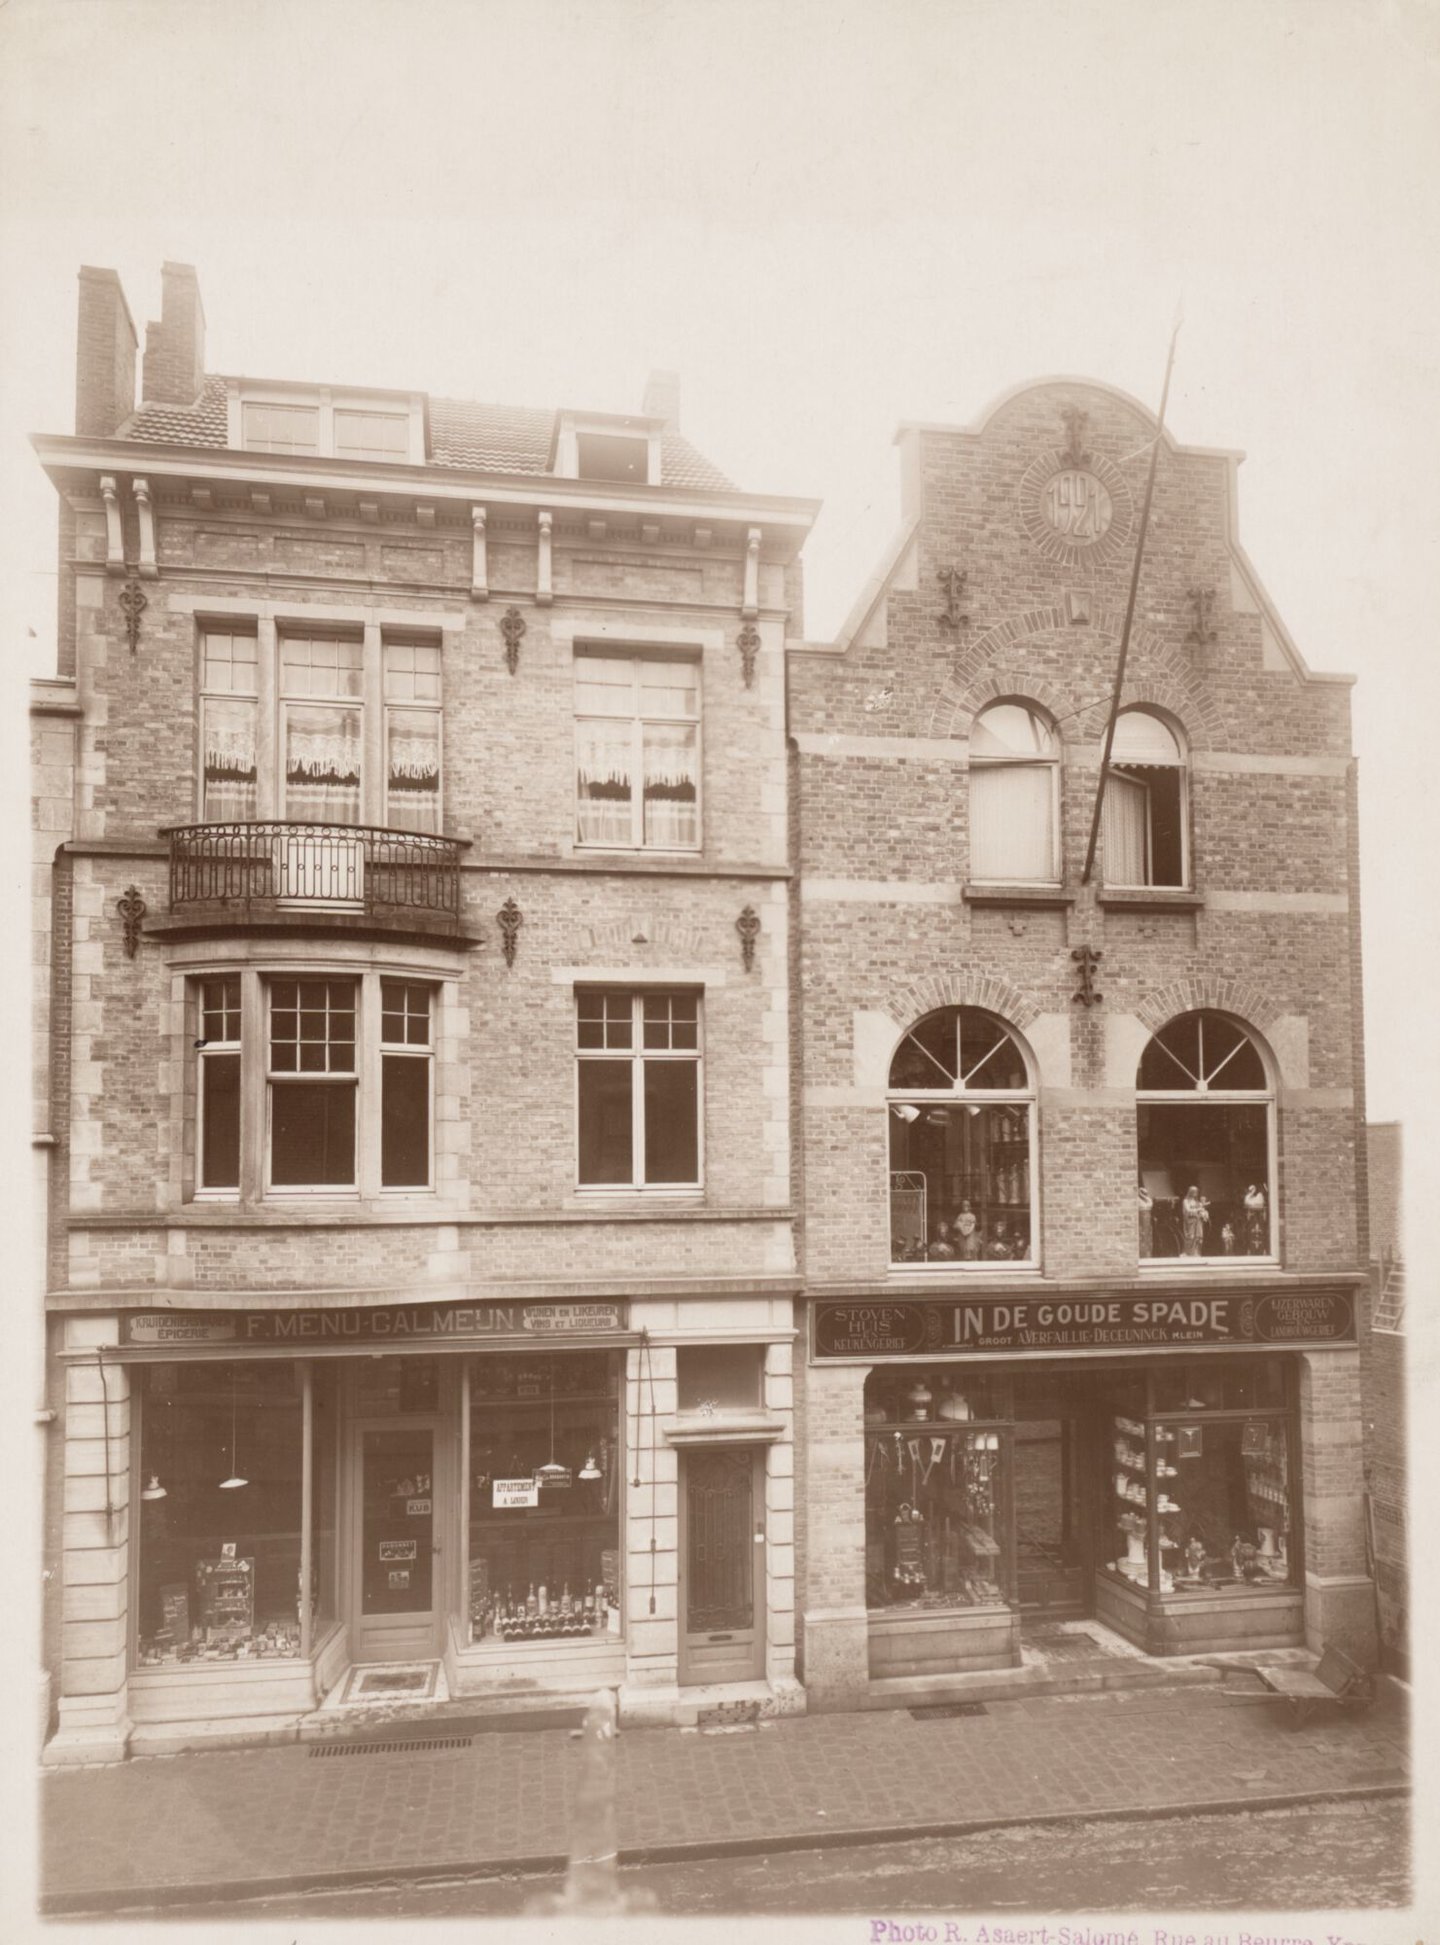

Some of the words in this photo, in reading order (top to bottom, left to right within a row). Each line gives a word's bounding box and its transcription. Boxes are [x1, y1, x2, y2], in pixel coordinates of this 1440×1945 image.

[1047, 472, 1101, 538] 1921
[834, 1308, 906, 1321] STOVEN
[953, 1307, 984, 1342] IN
[993, 1306, 1028, 1332] DE
[1037, 1304, 1121, 1325] GOUDE
[1132, 1300, 1230, 1333] SPADE
[979, 1336, 1012, 1346] GROOT
[1172, 1331, 1204, 1340] KLEIN
